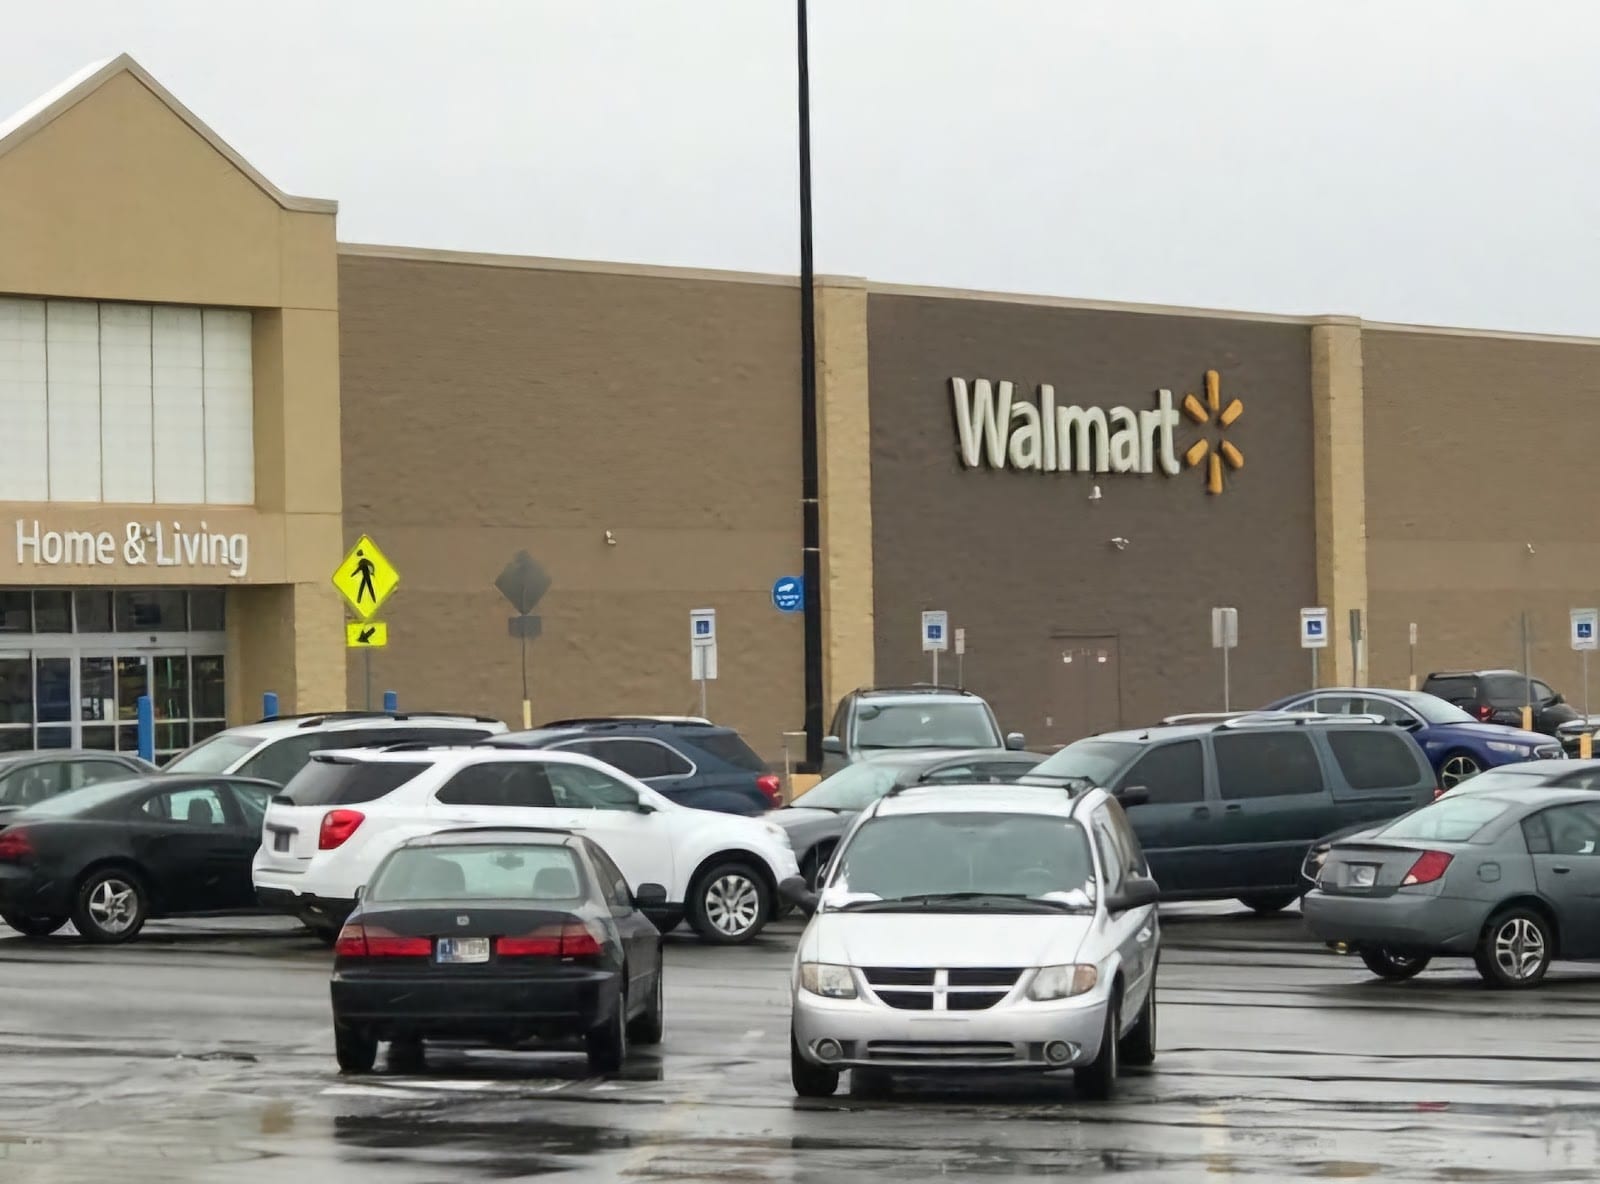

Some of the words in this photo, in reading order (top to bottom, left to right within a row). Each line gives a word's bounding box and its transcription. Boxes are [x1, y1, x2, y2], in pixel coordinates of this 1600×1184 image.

[951, 377, 1180, 475] Walmart
[16, 519, 116, 566] Home
[123, 521, 147, 566] &
[155, 520, 248, 578] Living
